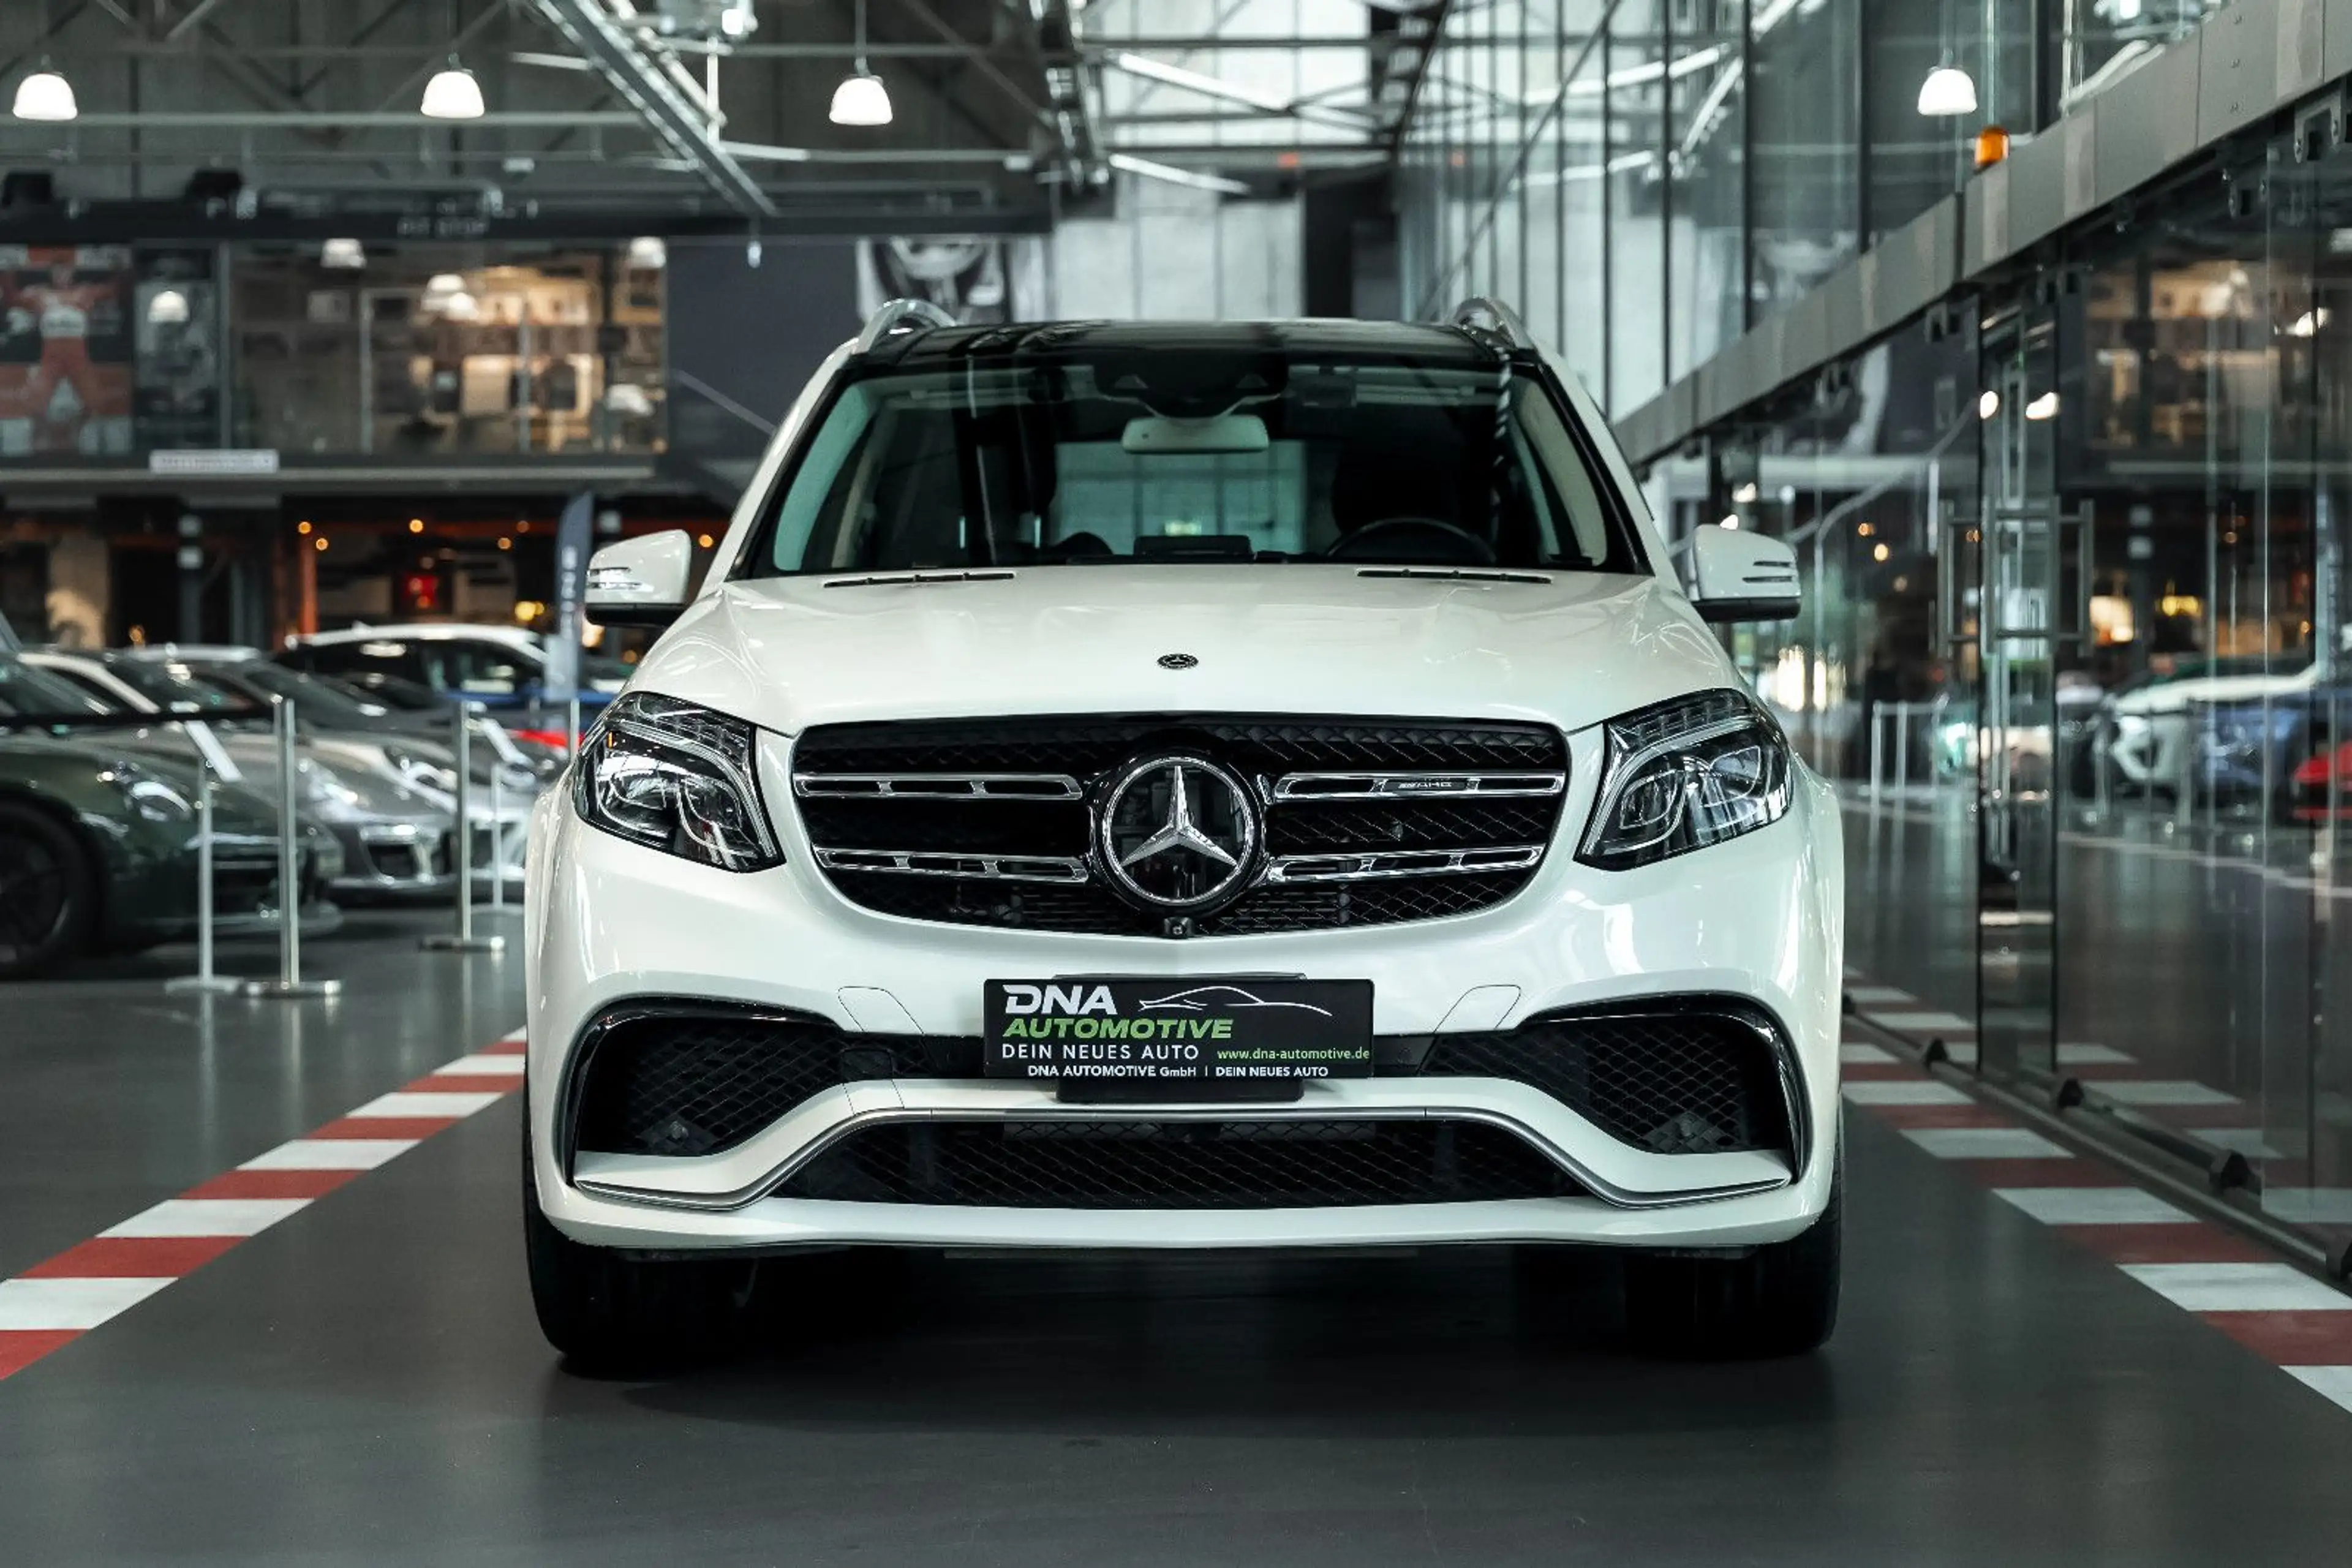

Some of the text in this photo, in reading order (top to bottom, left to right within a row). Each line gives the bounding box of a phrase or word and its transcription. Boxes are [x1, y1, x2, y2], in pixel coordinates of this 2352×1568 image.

[1003, 985, 1118, 1014] DNA
[1003, 1018, 1234, 1039] AUTOMOTIVE
[1003, 1043, 1199, 1060] DEIN NEUES AUTO
[1217, 1047, 1370, 1060] www.dna-automotive.de
[1028, 1065, 1196, 1077] DNA AUTOMOTIVE GmbH
[1216, 1066, 1329, 1077] DEIN NEUES AUTO
